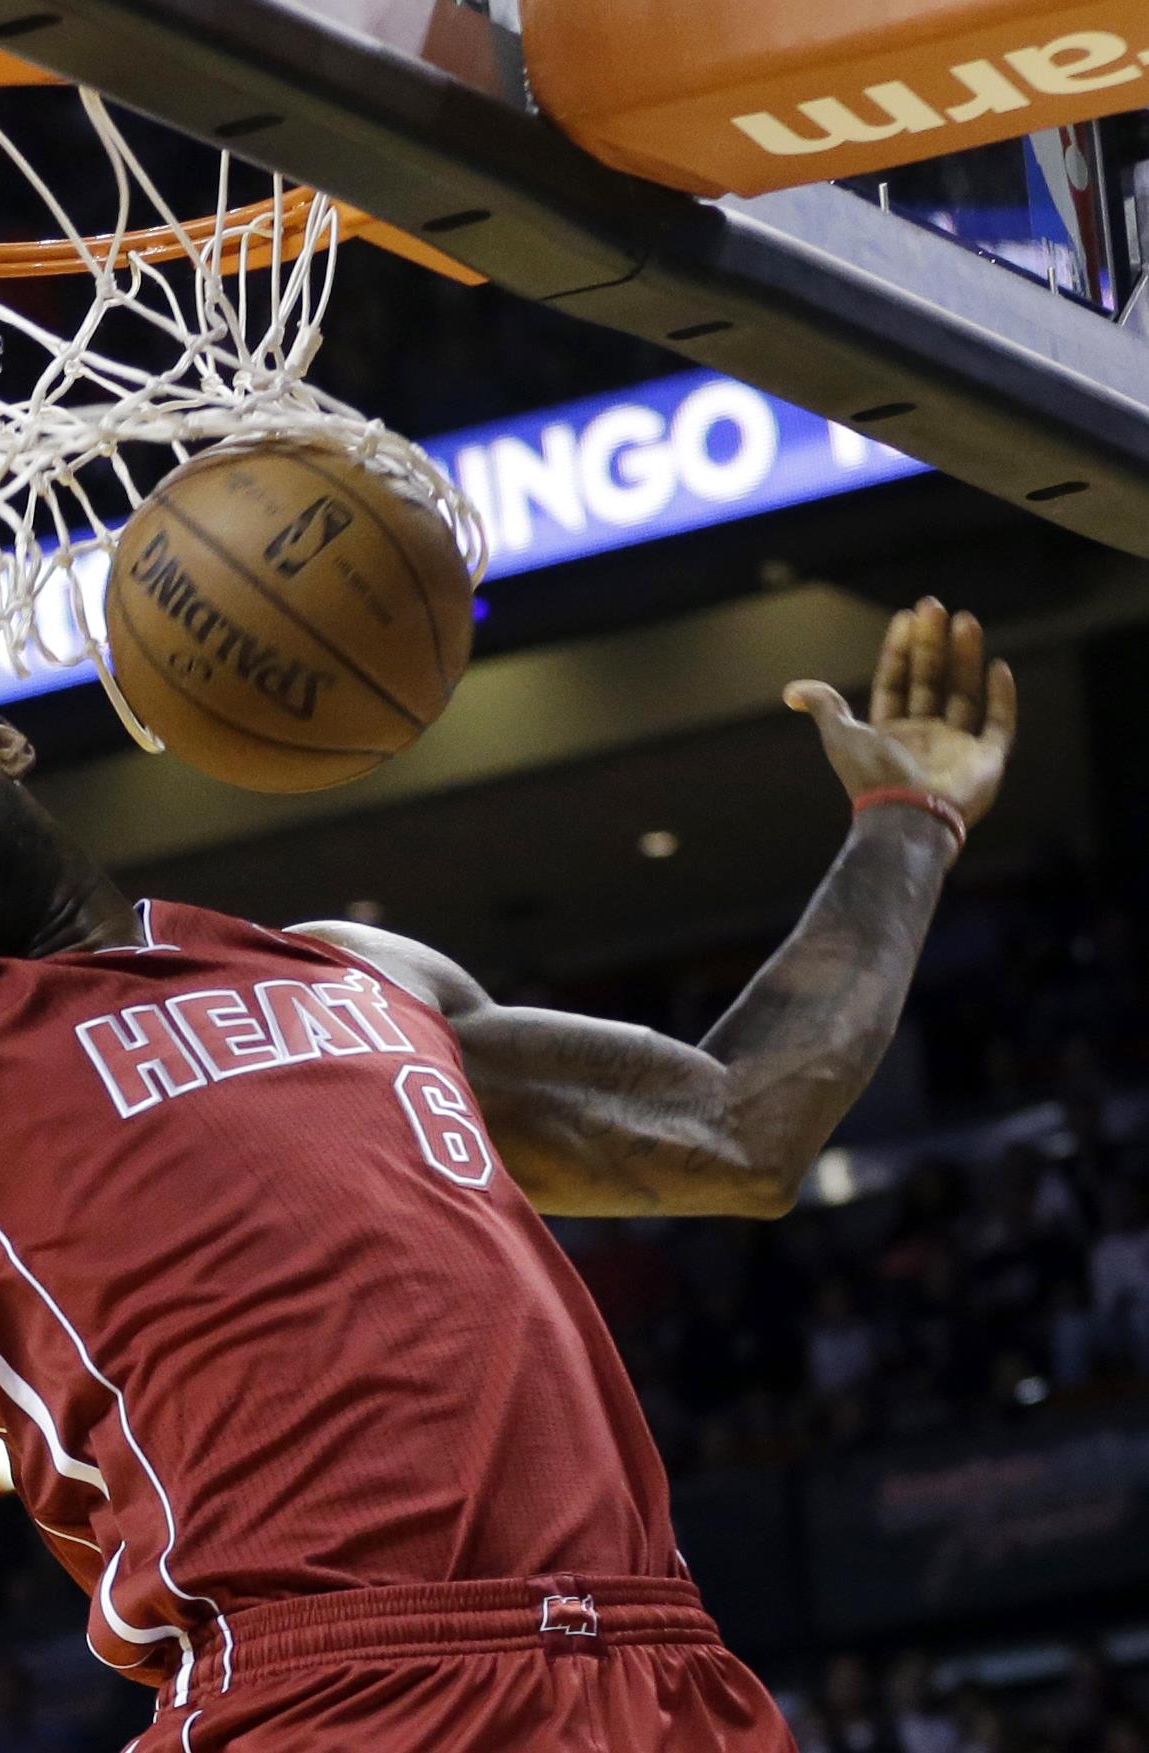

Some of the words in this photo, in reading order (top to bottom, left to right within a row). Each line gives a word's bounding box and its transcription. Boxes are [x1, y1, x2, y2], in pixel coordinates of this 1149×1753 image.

[731, 30, 1149, 156] arm
[457, 379, 778, 560] INGO
[130, 531, 337, 720] SPALDING
[74, 968, 416, 1119] HEAT
[393, 1063, 496, 1190] 6
